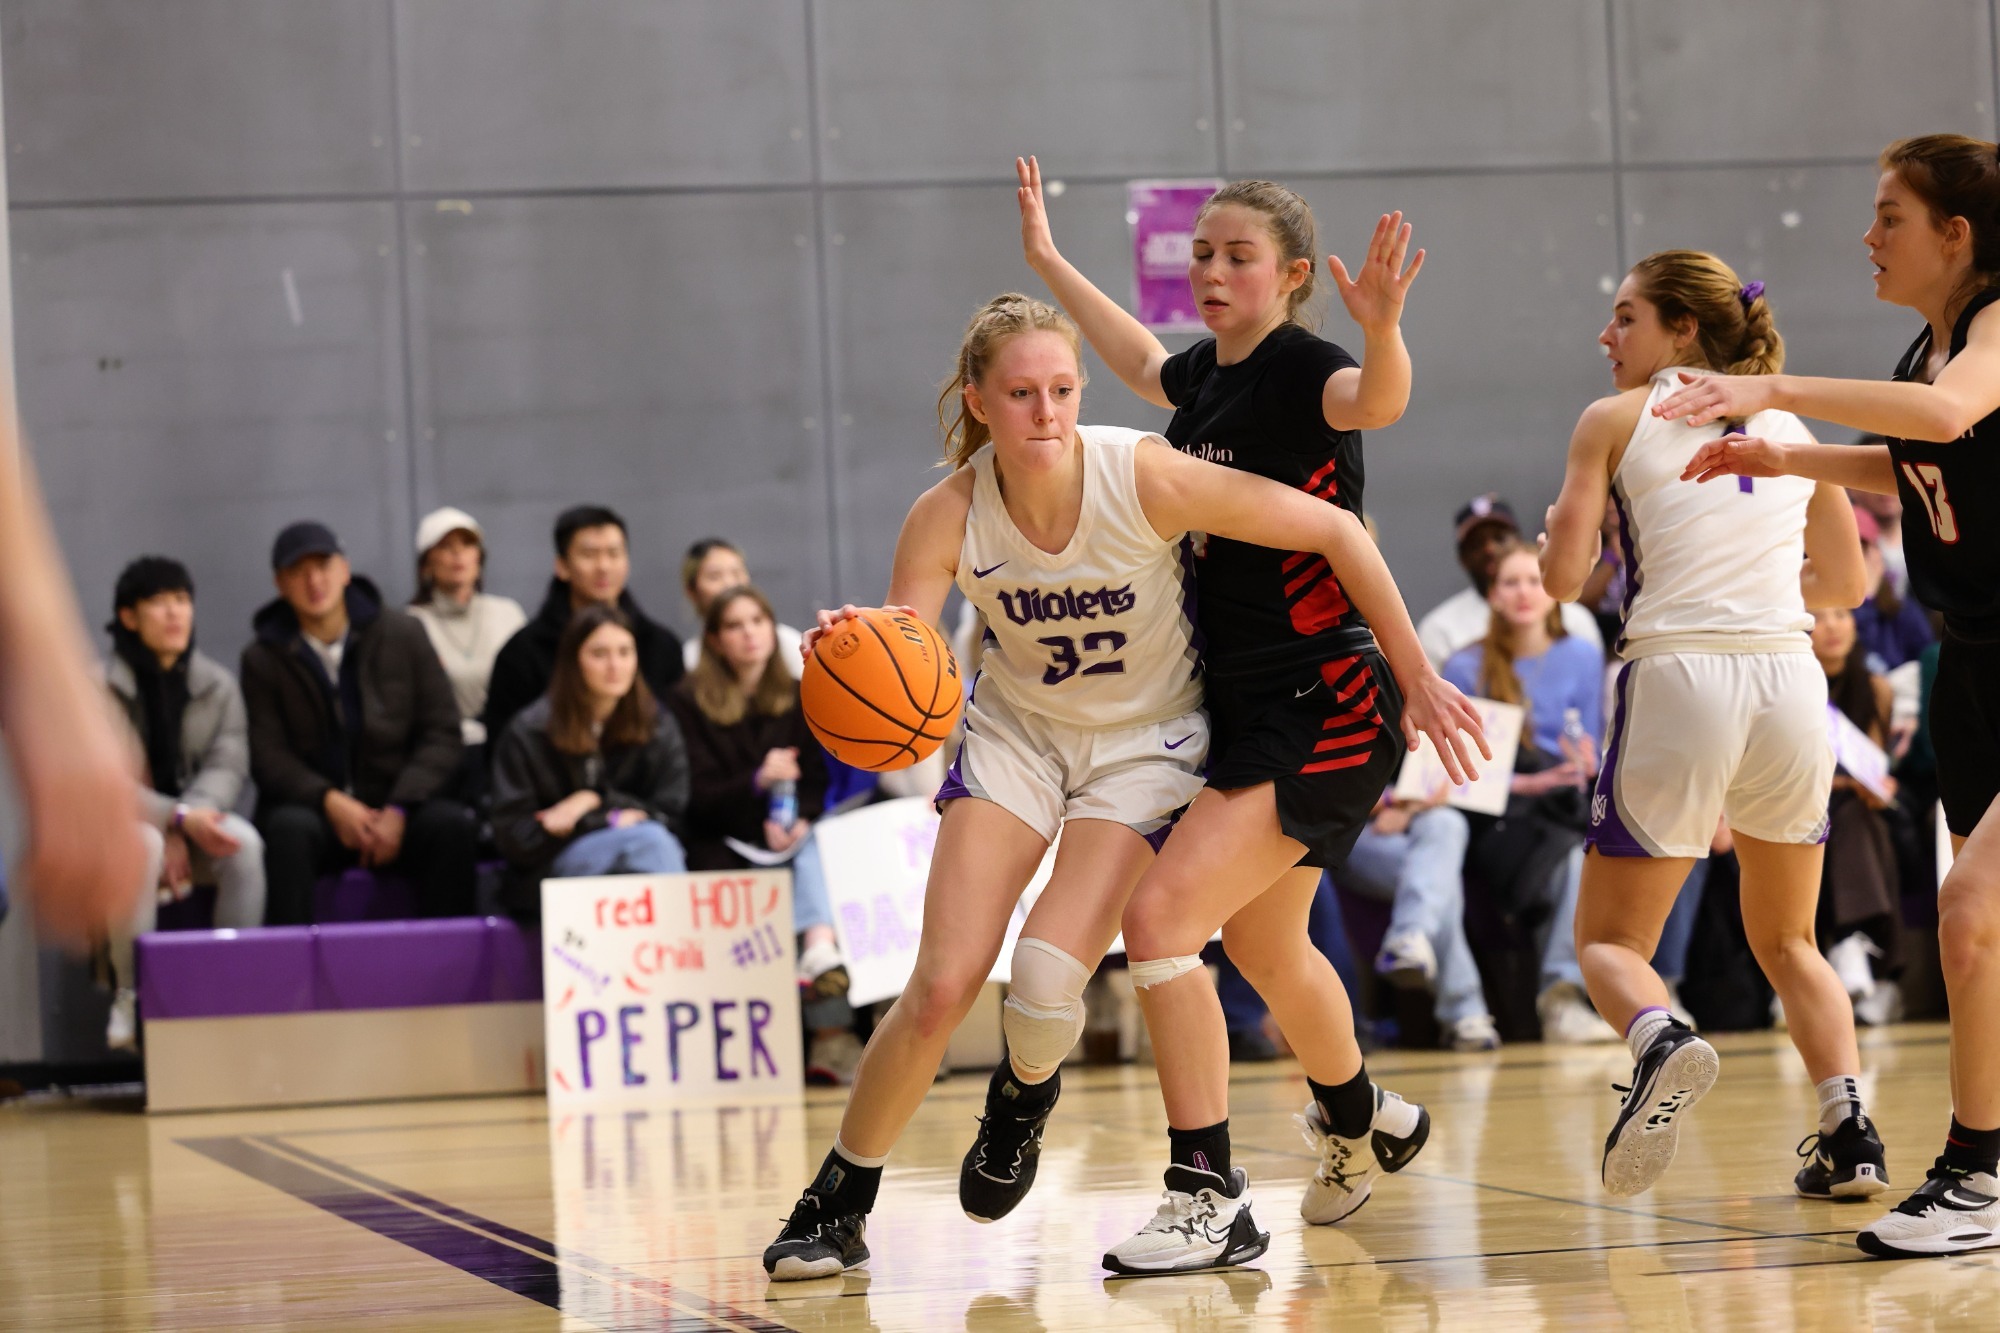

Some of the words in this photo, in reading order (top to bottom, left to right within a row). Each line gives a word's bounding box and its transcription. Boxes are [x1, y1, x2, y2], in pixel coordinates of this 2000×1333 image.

[1900, 461, 1961, 545] 13
[996, 581, 1136, 627] Violets
[1035, 630, 1129, 686] 32
[594, 886, 655, 929] red
[690, 878, 757, 929] HOT
[577, 1000, 778, 1090] PEPER
